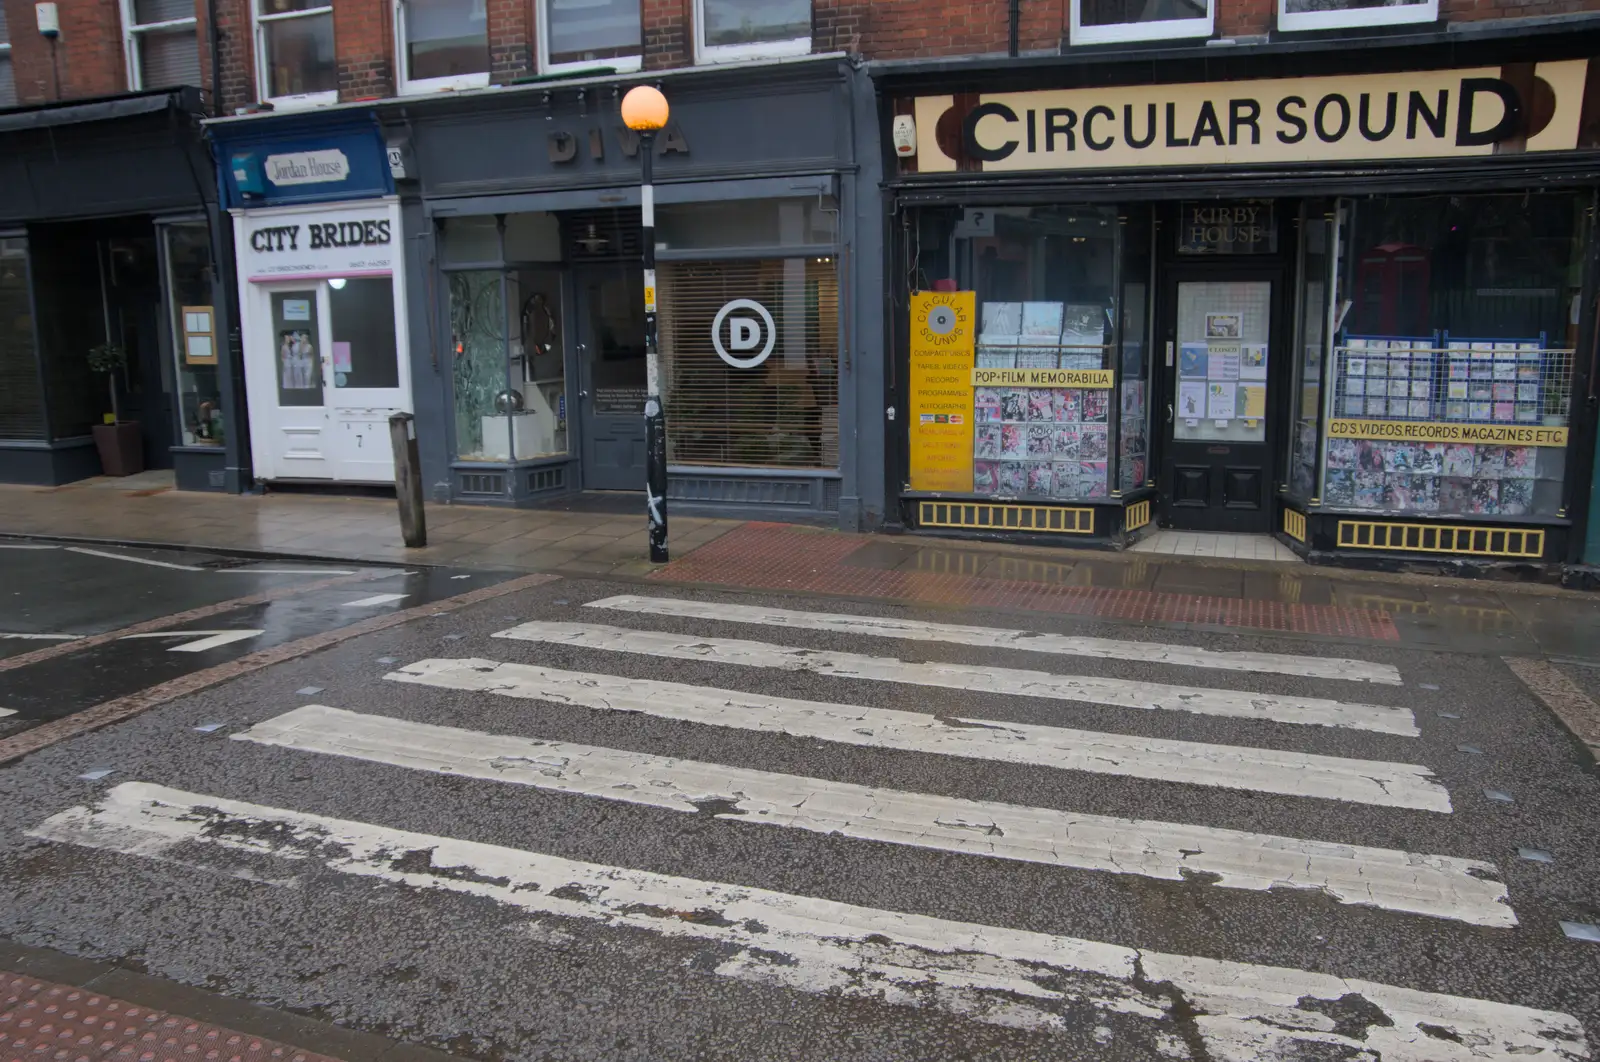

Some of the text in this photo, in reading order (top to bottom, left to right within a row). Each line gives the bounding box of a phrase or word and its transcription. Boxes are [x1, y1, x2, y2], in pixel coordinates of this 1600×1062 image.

[963, 78, 1522, 162] CIRCULAR SOUND
[547, 120, 690, 163] DIVA
[273, 157, 341, 180] Jordan House
[250, 220, 391, 253] CITY BRIDES
[1191, 207, 1262, 243] KIRBY HOUSE
[917, 295, 967, 323] CIRCULAR
[729, 317, 761, 350] D
[919, 327, 964, 346] SOUNDS
[913, 349, 947, 357] COMPACT
[1031, 372, 1109, 384] MEMORABILIA
[917, 389, 969, 397] PROGRAMMES
[919, 402, 967, 410] AUTOGRAPHS
[1462, 427, 1533, 442] MAGAZINES
